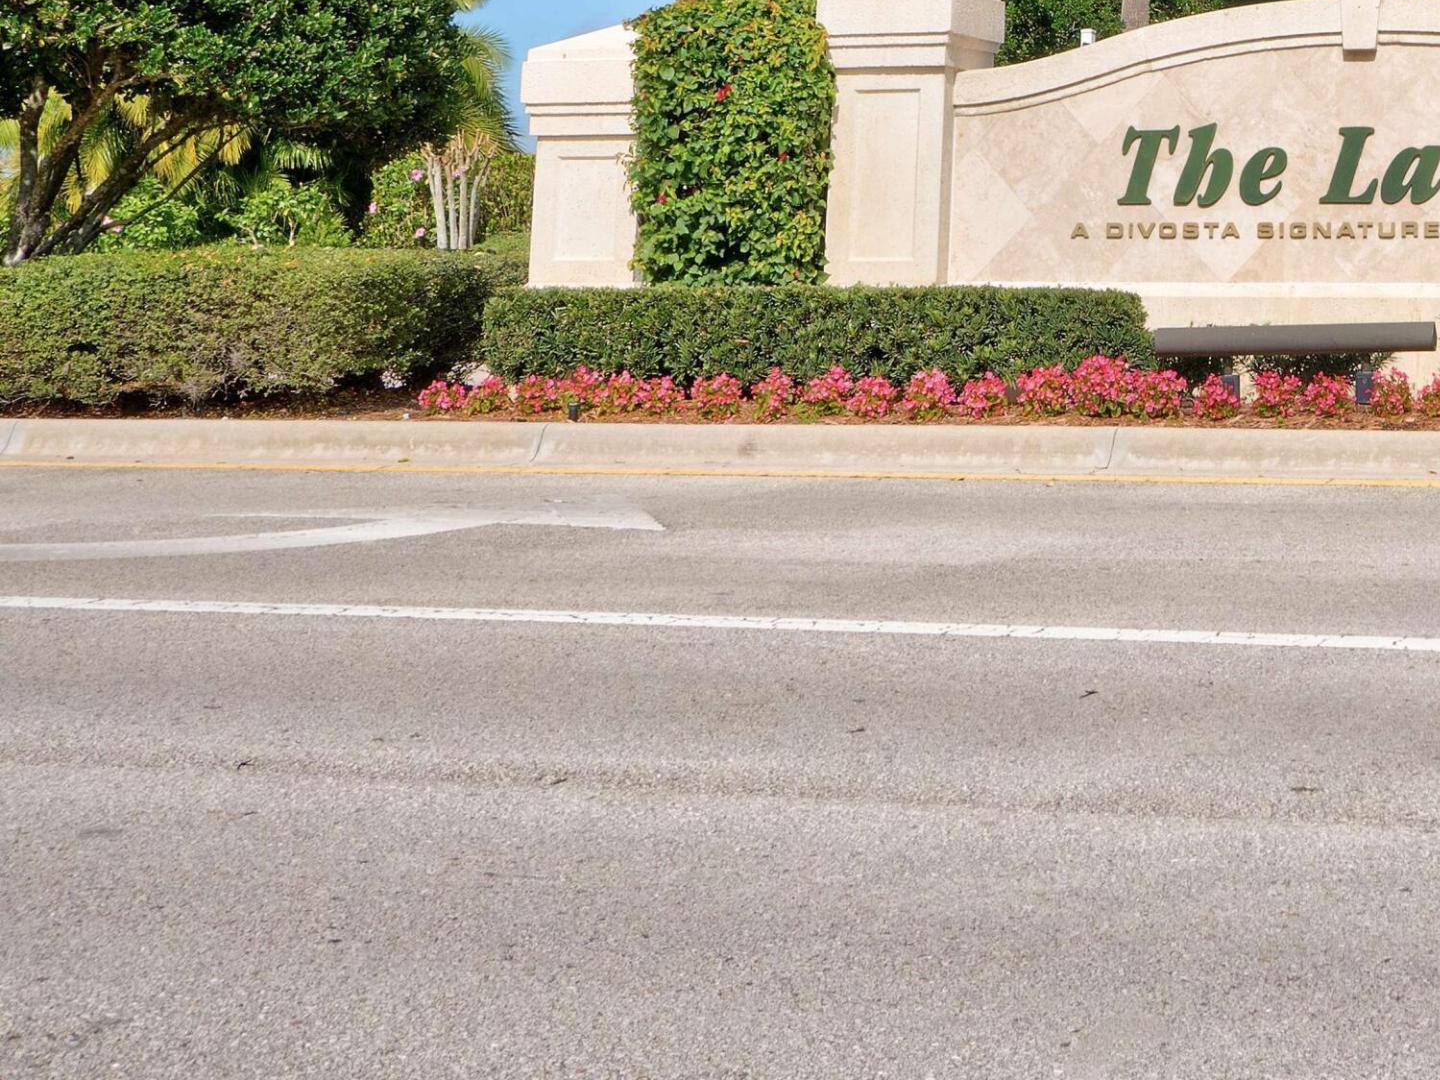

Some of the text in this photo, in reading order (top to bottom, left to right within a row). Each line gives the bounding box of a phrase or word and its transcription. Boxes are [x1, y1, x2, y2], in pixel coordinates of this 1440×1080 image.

[1117, 123, 1288, 208] The
[1071, 223, 1089, 239] A
[1106, 223, 1240, 239] DIVOSTA
[1257, 222, 1440, 239] SIGNATURE
